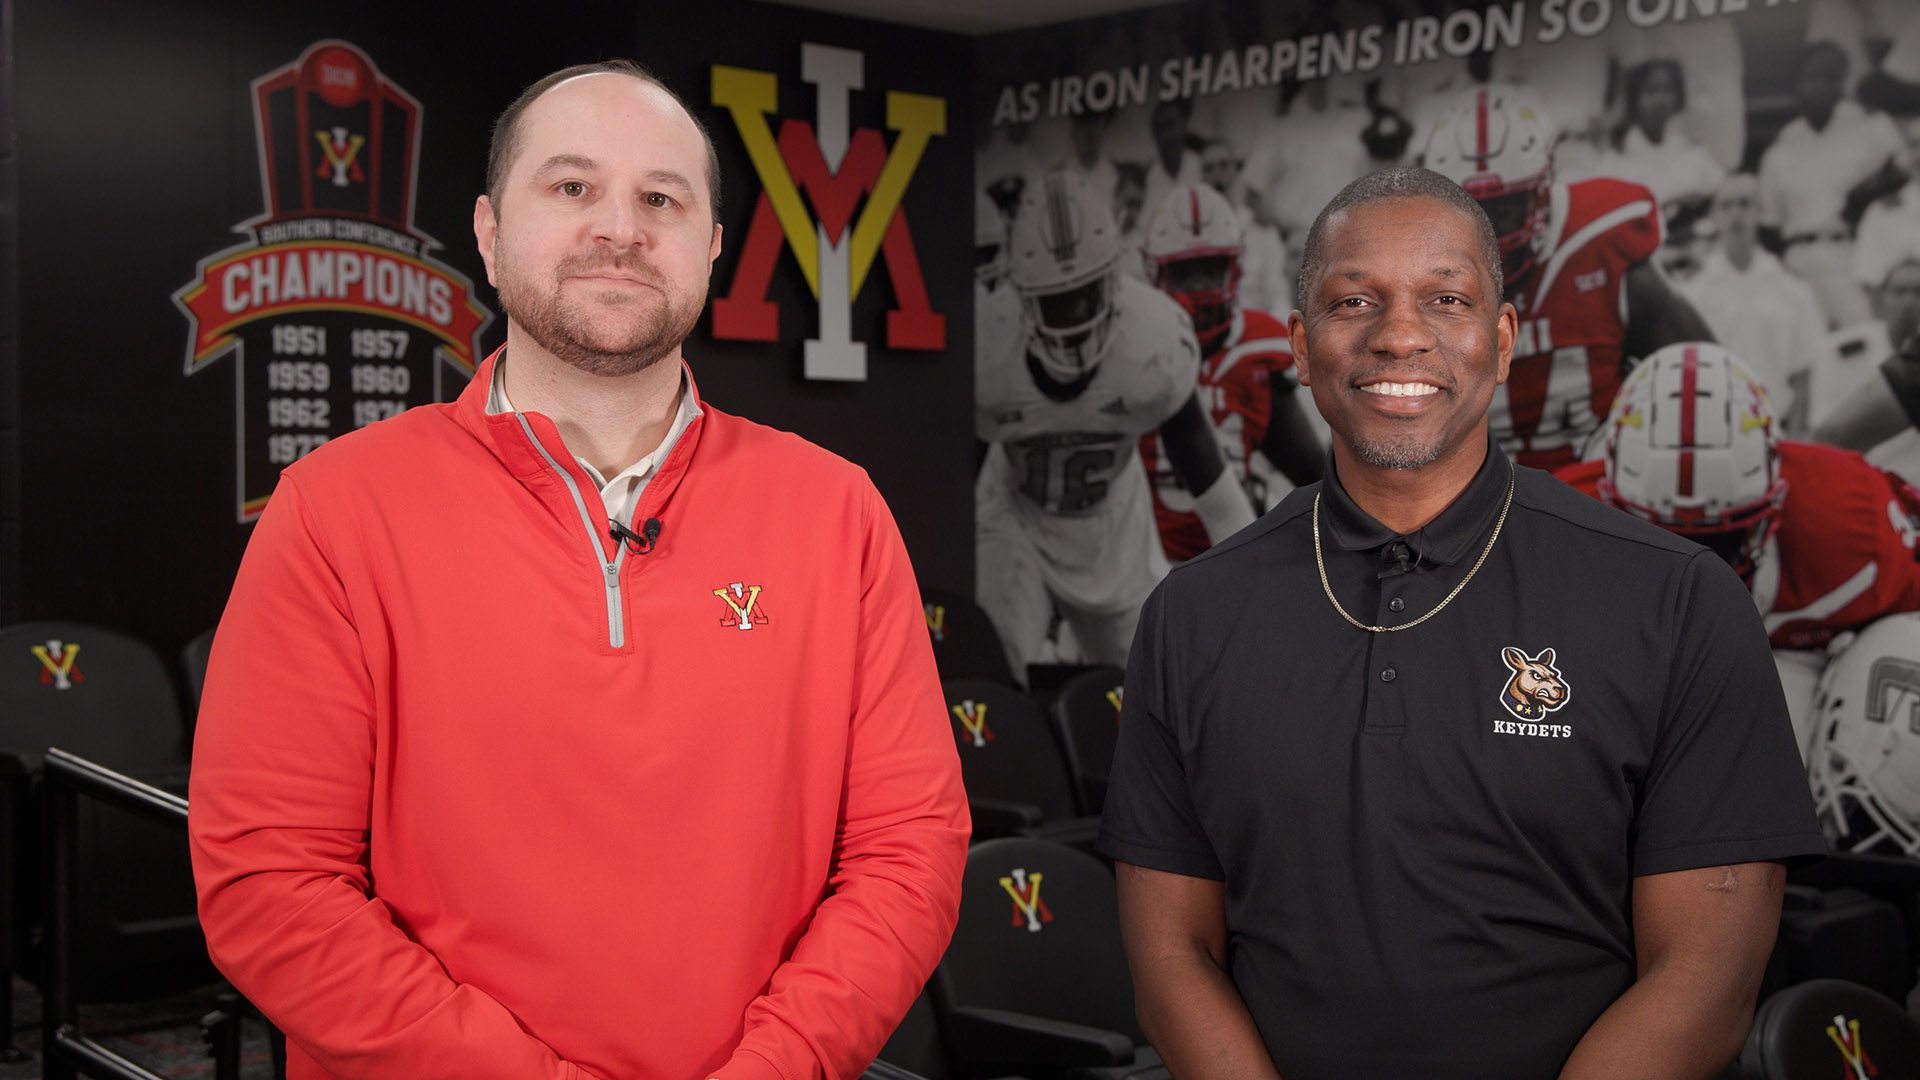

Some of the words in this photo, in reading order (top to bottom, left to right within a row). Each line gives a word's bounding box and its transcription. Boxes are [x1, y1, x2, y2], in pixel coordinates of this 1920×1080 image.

[993, 80, 1040, 126] AS
[1049, 64, 1150, 117] IRON
[1159, 25, 1384, 100] SHARPENS
[1395, 2, 1524, 64] IRON
[1537, 0, 1610, 43] SO
[261, 219, 334, 245] SOUTHERN
[334, 219, 419, 253] CONFERENCE
[222, 250, 453, 325] CHAMPIONS
[272, 324, 327, 355] 1951
[351, 329, 409, 359] 1957
[268, 362, 330, 392] 1959
[351, 366, 410, 394] 1960
[268, 399, 330, 428] 1962
[1493, 720, 1572, 738] KEYDETS
